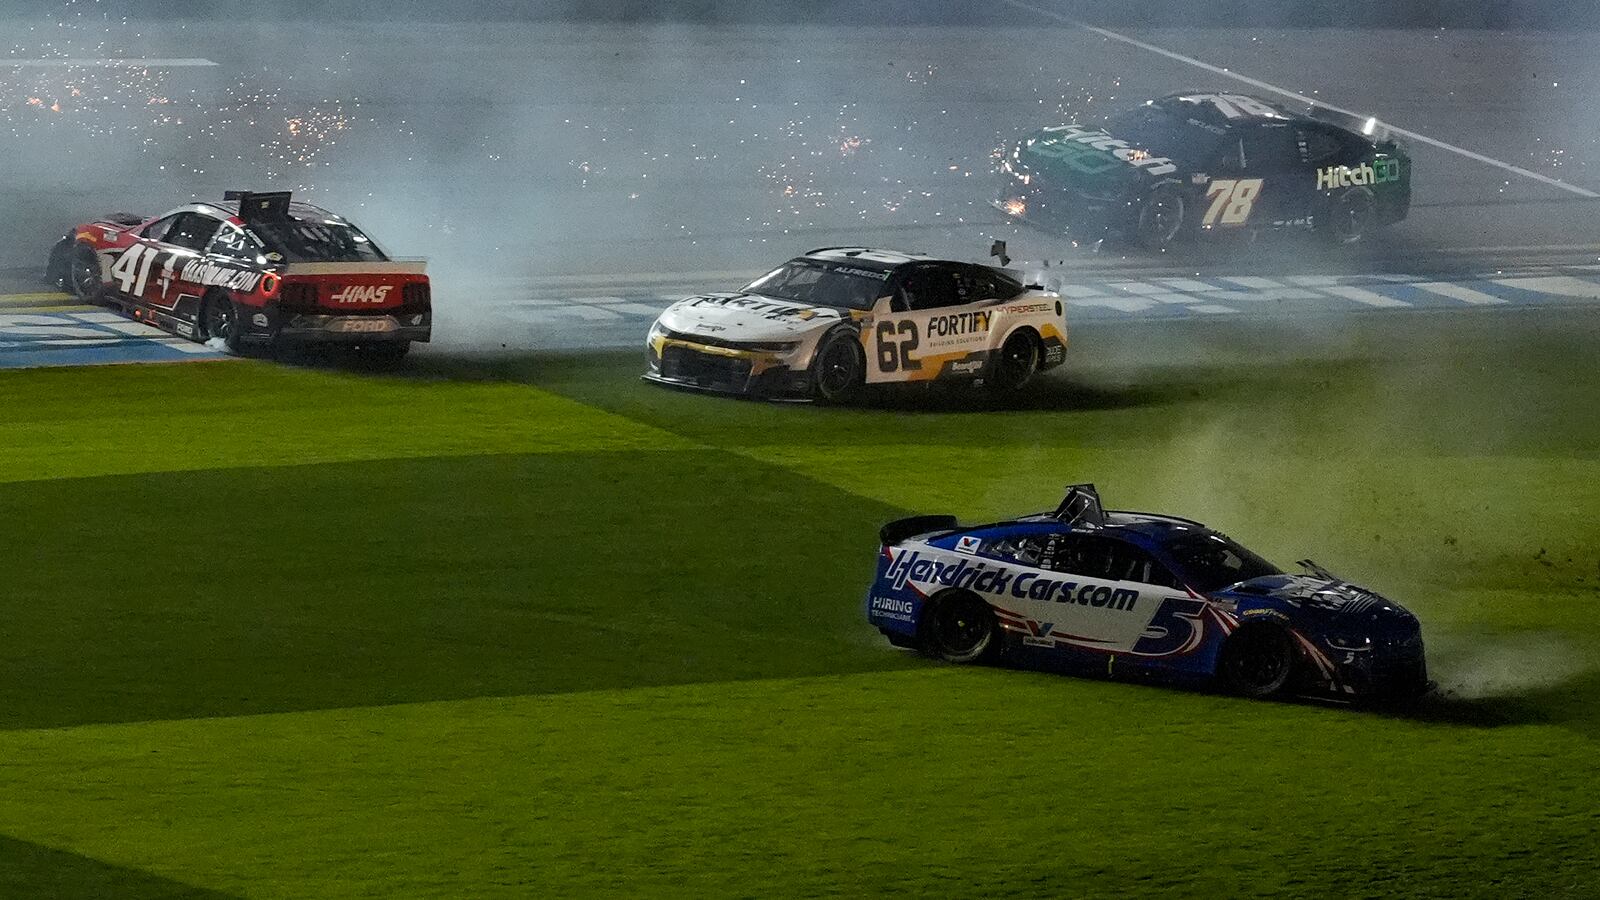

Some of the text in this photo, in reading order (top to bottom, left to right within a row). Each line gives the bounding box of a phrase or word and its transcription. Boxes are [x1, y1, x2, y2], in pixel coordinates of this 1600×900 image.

[1202, 178, 1264, 226] 78
[111, 243, 158, 297] 41
[331, 285, 394, 303] HAAS
[343, 321, 387, 332] FORD
[927, 310, 992, 339] FORTIFY
[877, 320, 922, 373] 62
[872, 597, 913, 614] HIRING
[1132, 597, 1204, 656] 5
[1343, 652, 1355, 664] 5
